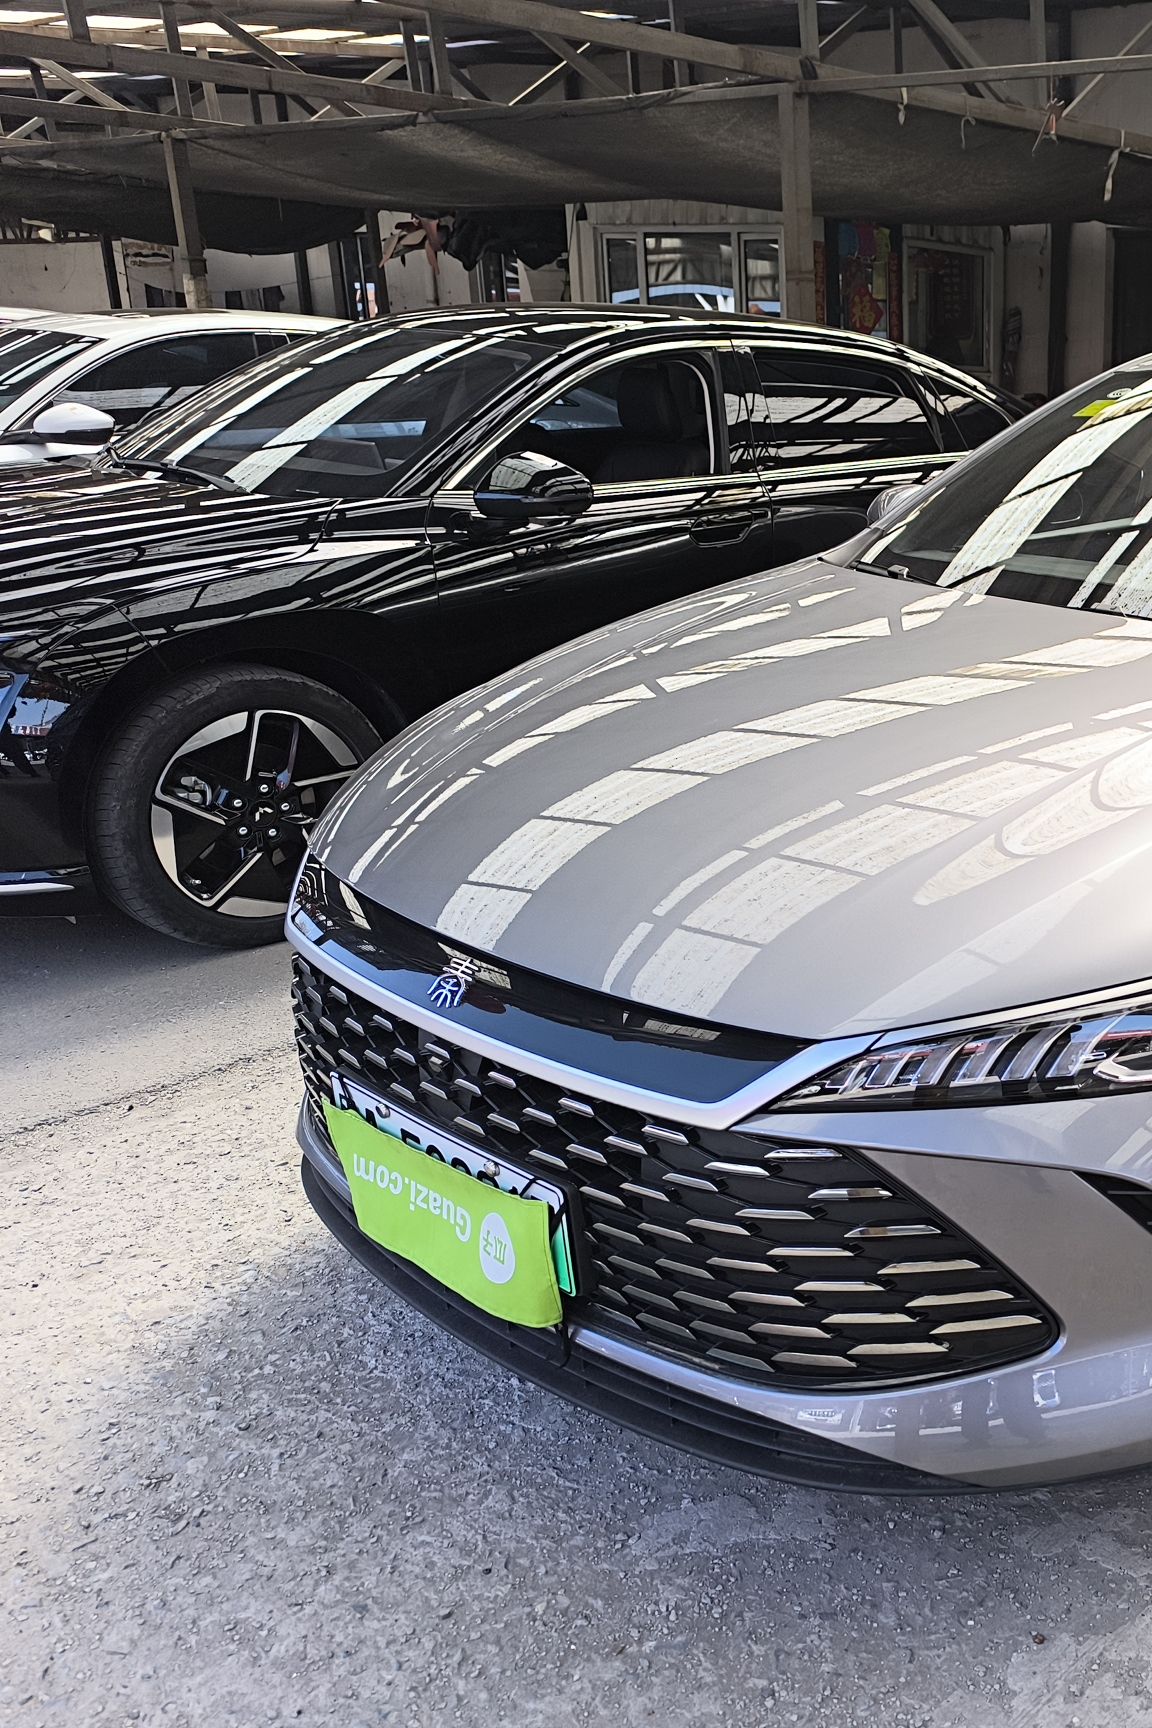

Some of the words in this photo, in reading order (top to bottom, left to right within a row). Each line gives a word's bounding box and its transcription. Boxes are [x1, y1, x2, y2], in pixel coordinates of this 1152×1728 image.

[852, 294, 876, 328] 福
[353, 1153, 472, 1243] Guazi.com
[483, 1230, 507, 1266] 瓜子
